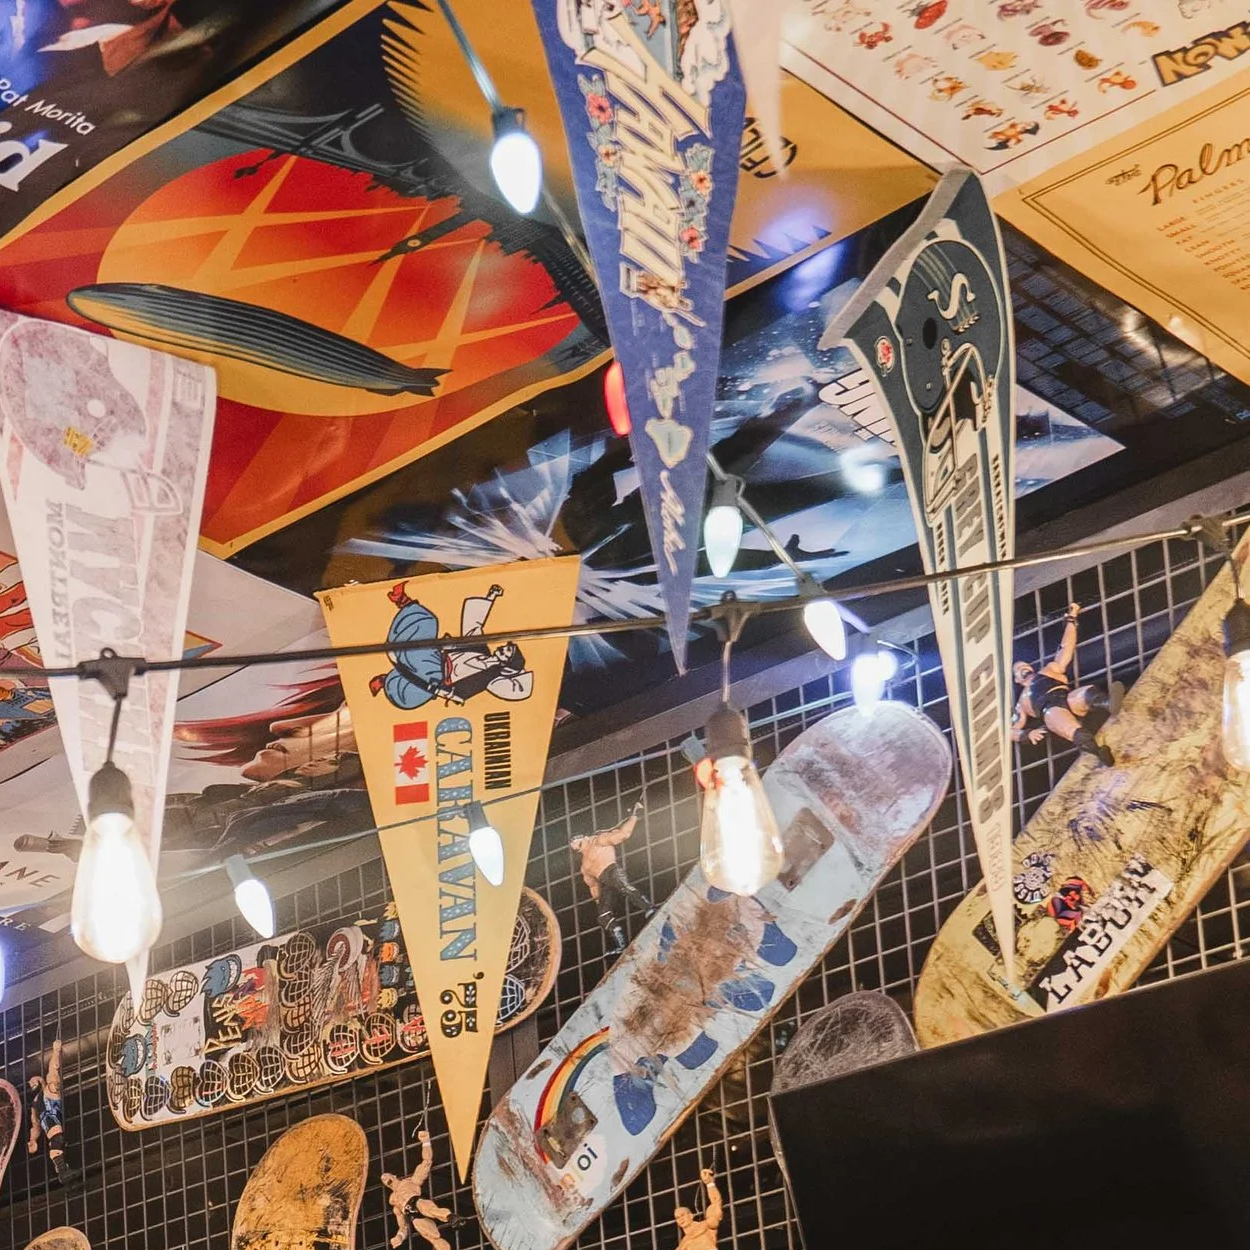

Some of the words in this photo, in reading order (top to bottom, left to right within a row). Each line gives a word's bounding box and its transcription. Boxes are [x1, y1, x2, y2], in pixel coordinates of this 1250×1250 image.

[24, 99, 97, 137] Morita
[482, 711, 512, 791] UKRAINIAN
[966, 652, 1002, 827] CHAMPS
[433, 716, 481, 963] CARAVAN
